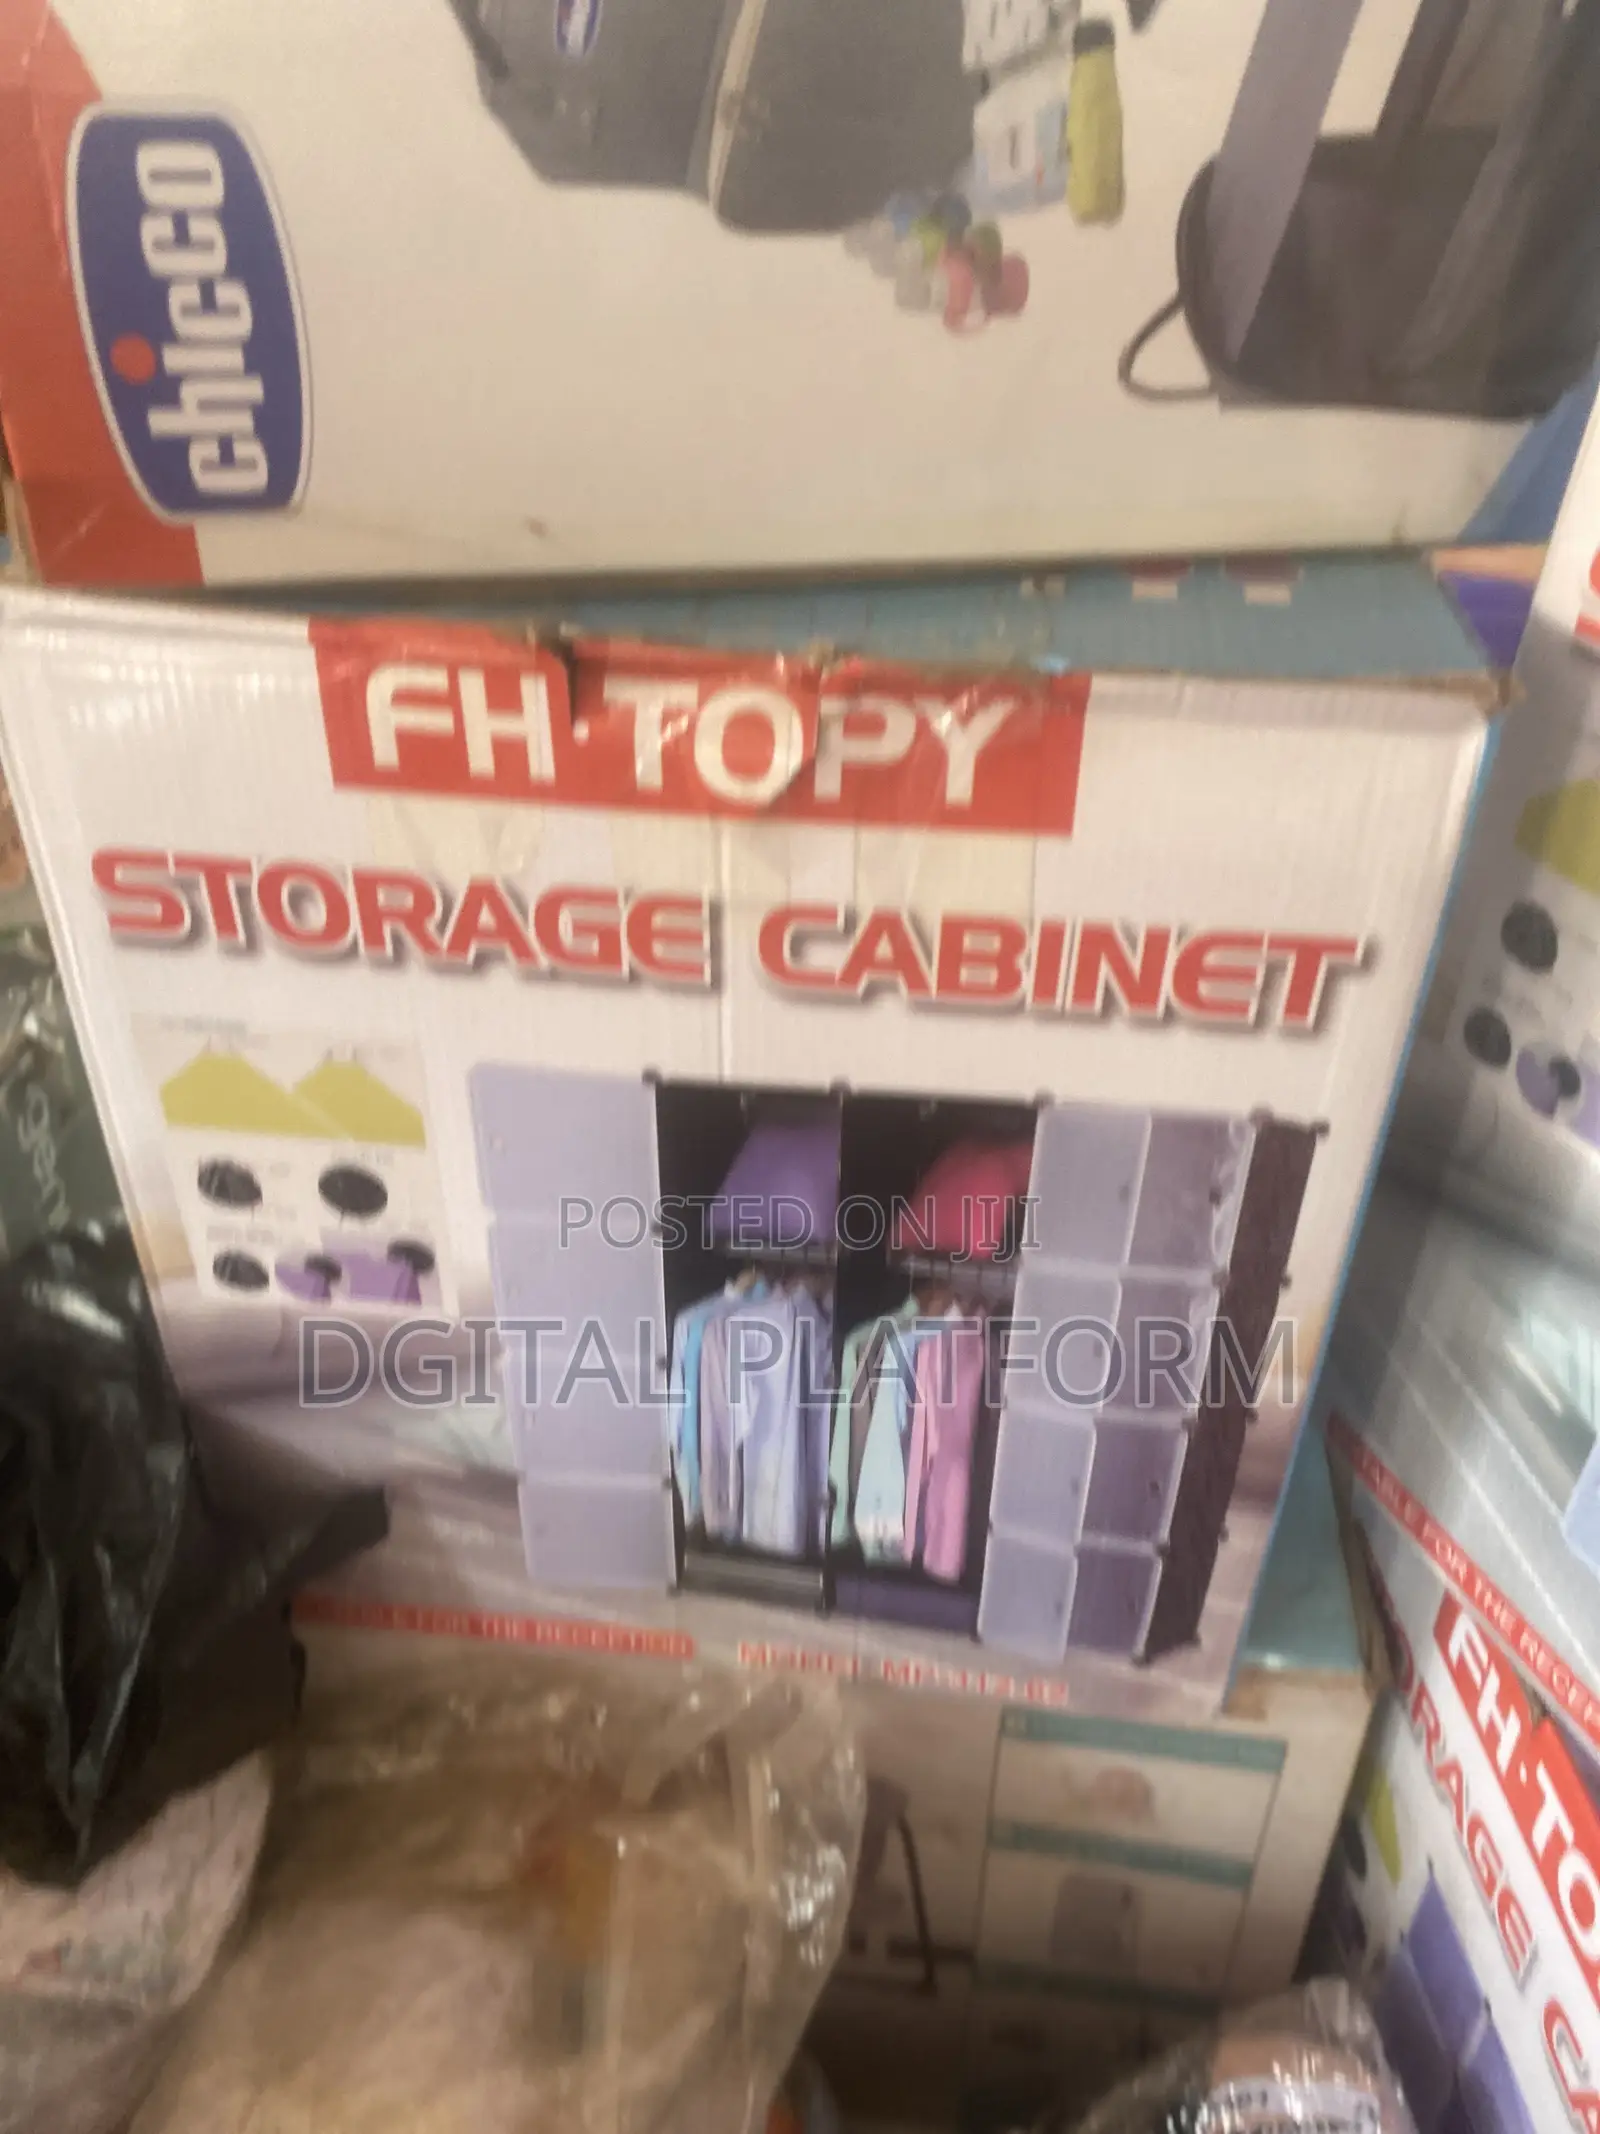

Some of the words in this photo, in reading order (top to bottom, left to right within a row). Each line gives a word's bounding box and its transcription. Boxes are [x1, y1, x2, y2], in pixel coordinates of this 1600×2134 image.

[110, 137, 269, 497] chico
[91, 850, 717, 990] STORAGE
[757, 905, 1370, 1034] CABINET
